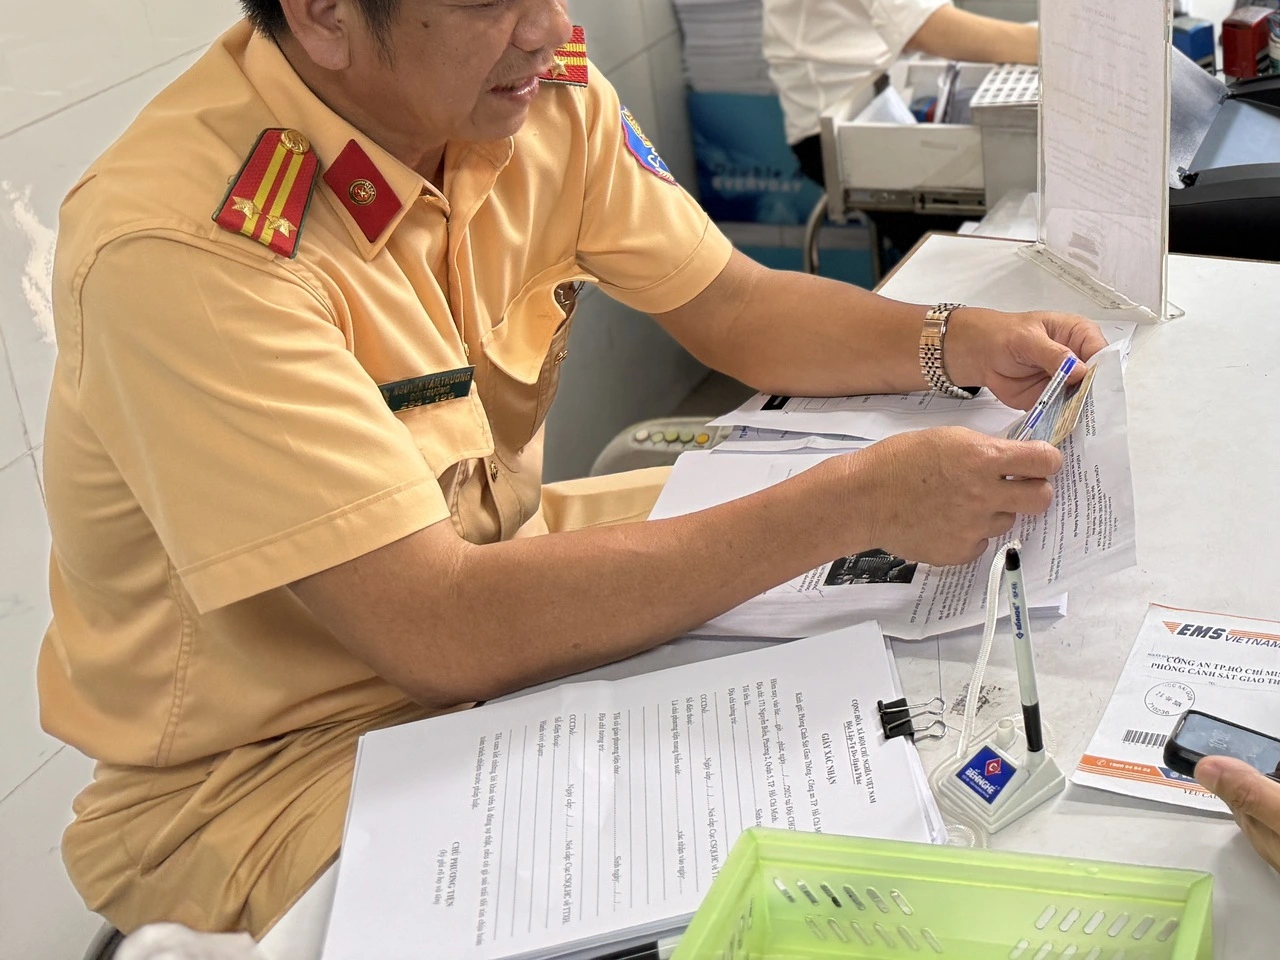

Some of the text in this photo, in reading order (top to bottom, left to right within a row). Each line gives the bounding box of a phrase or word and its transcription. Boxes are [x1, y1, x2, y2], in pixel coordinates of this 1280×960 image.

[1176, 623, 1226, 640] EMS
[1149, 662, 1186, 673] PHÒNG
[1186, 666, 1217, 677] CẢNH
[1216, 669, 1238, 680] SÁT
[1237, 674, 1265, 683] GIAO
[1165, 655, 1196, 666] CÔNG
[1243, 665, 1264, 675] CHÍ
[820, 731, 837, 785] GIẤY XÁC NHẬN
[850, 698, 860, 714] CỘNG
[867, 790, 876, 803] NAM
[443, 840, 462, 908] CHỦ PHƯƠNG TIỆN
